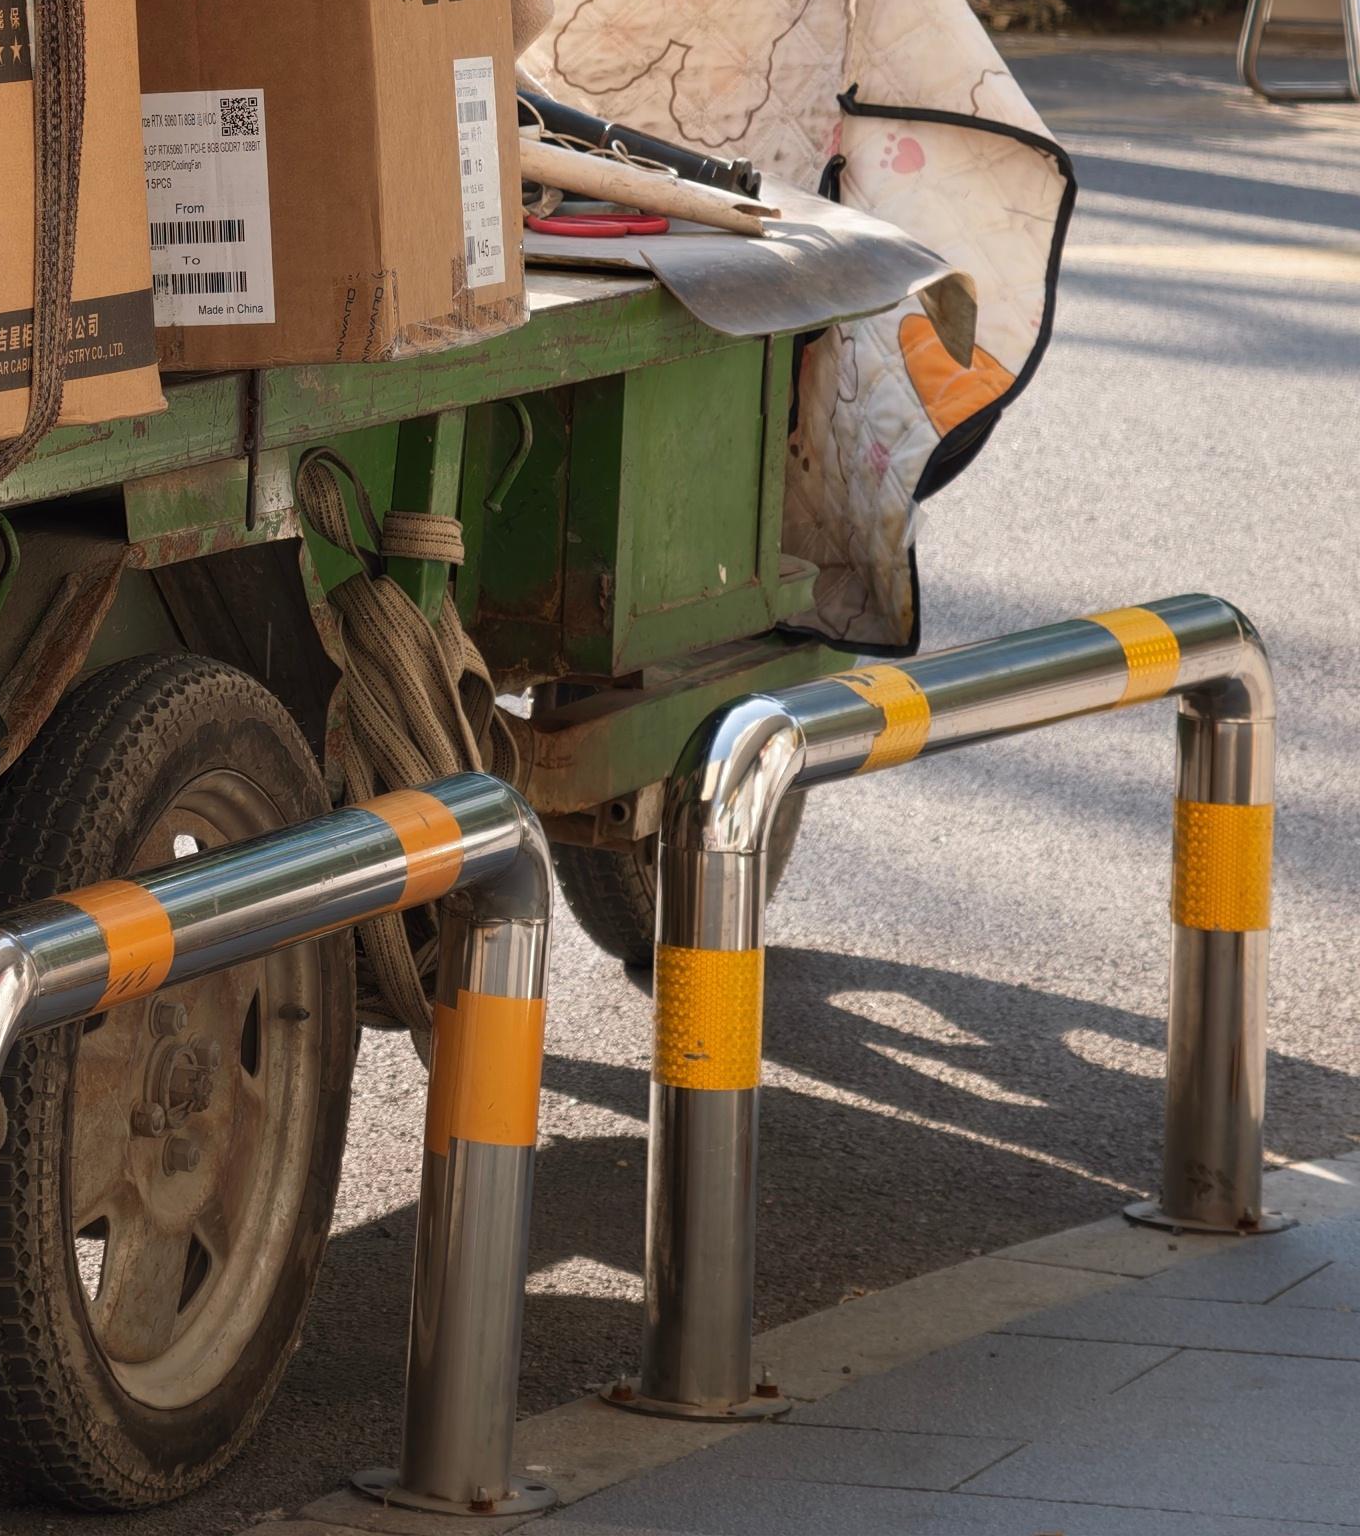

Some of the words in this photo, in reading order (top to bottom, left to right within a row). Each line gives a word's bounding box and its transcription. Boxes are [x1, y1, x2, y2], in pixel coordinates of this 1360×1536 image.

[152, 114, 162, 127] RTX
[146, 178, 172, 189] 15PCS
[175, 203, 204, 214] From
[182, 256, 200, 265] To
[198, 305, 223, 314] Made
[226, 305, 234, 313] in
[237, 304, 263, 313] China
